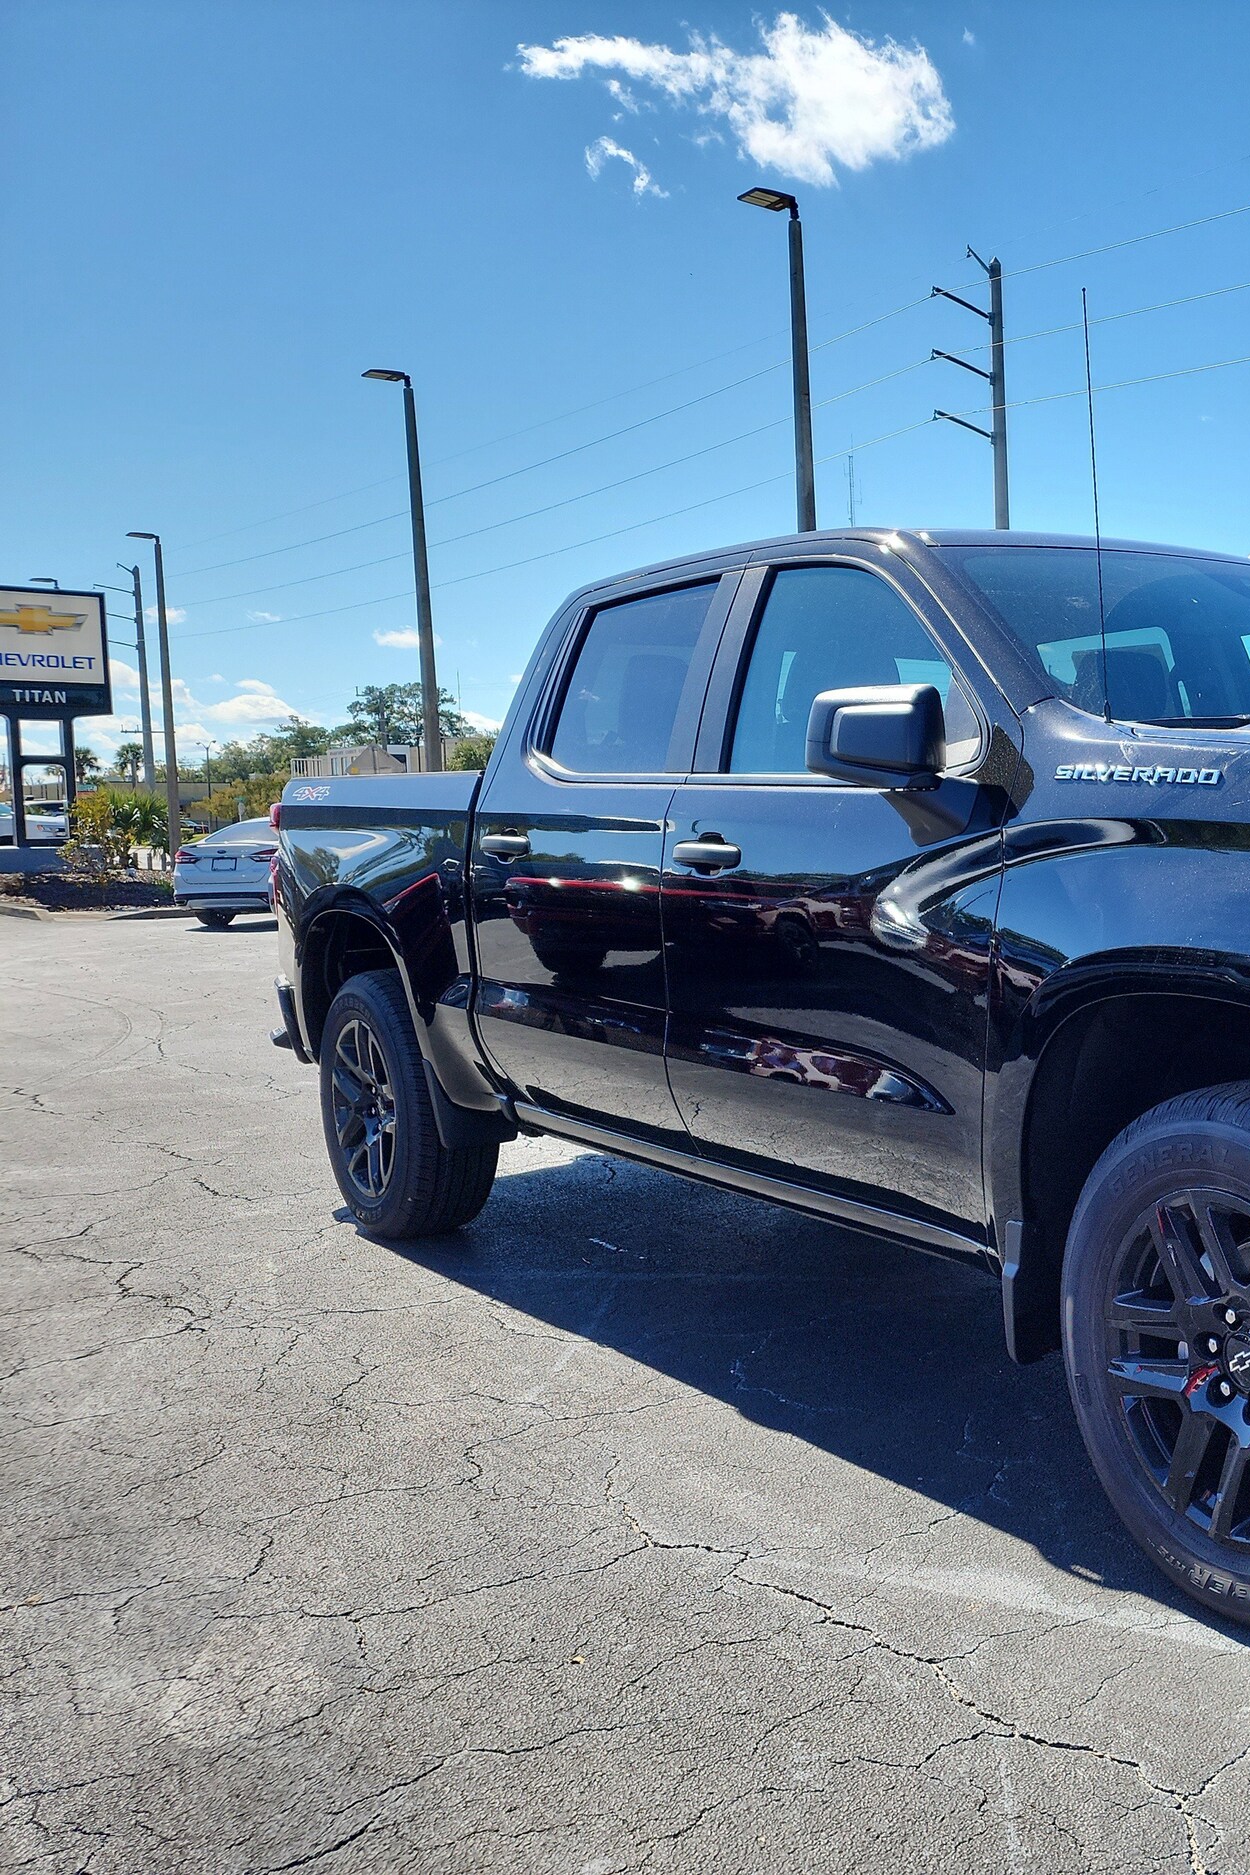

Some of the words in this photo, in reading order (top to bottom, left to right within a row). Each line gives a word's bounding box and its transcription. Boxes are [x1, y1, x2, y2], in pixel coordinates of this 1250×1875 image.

[0, 653, 96, 670] EVROLET
[11, 689, 67, 704] TITAN
[1054, 764, 1222, 786] SILVERADO
[1110, 1142, 1236, 1196] GENERAL
